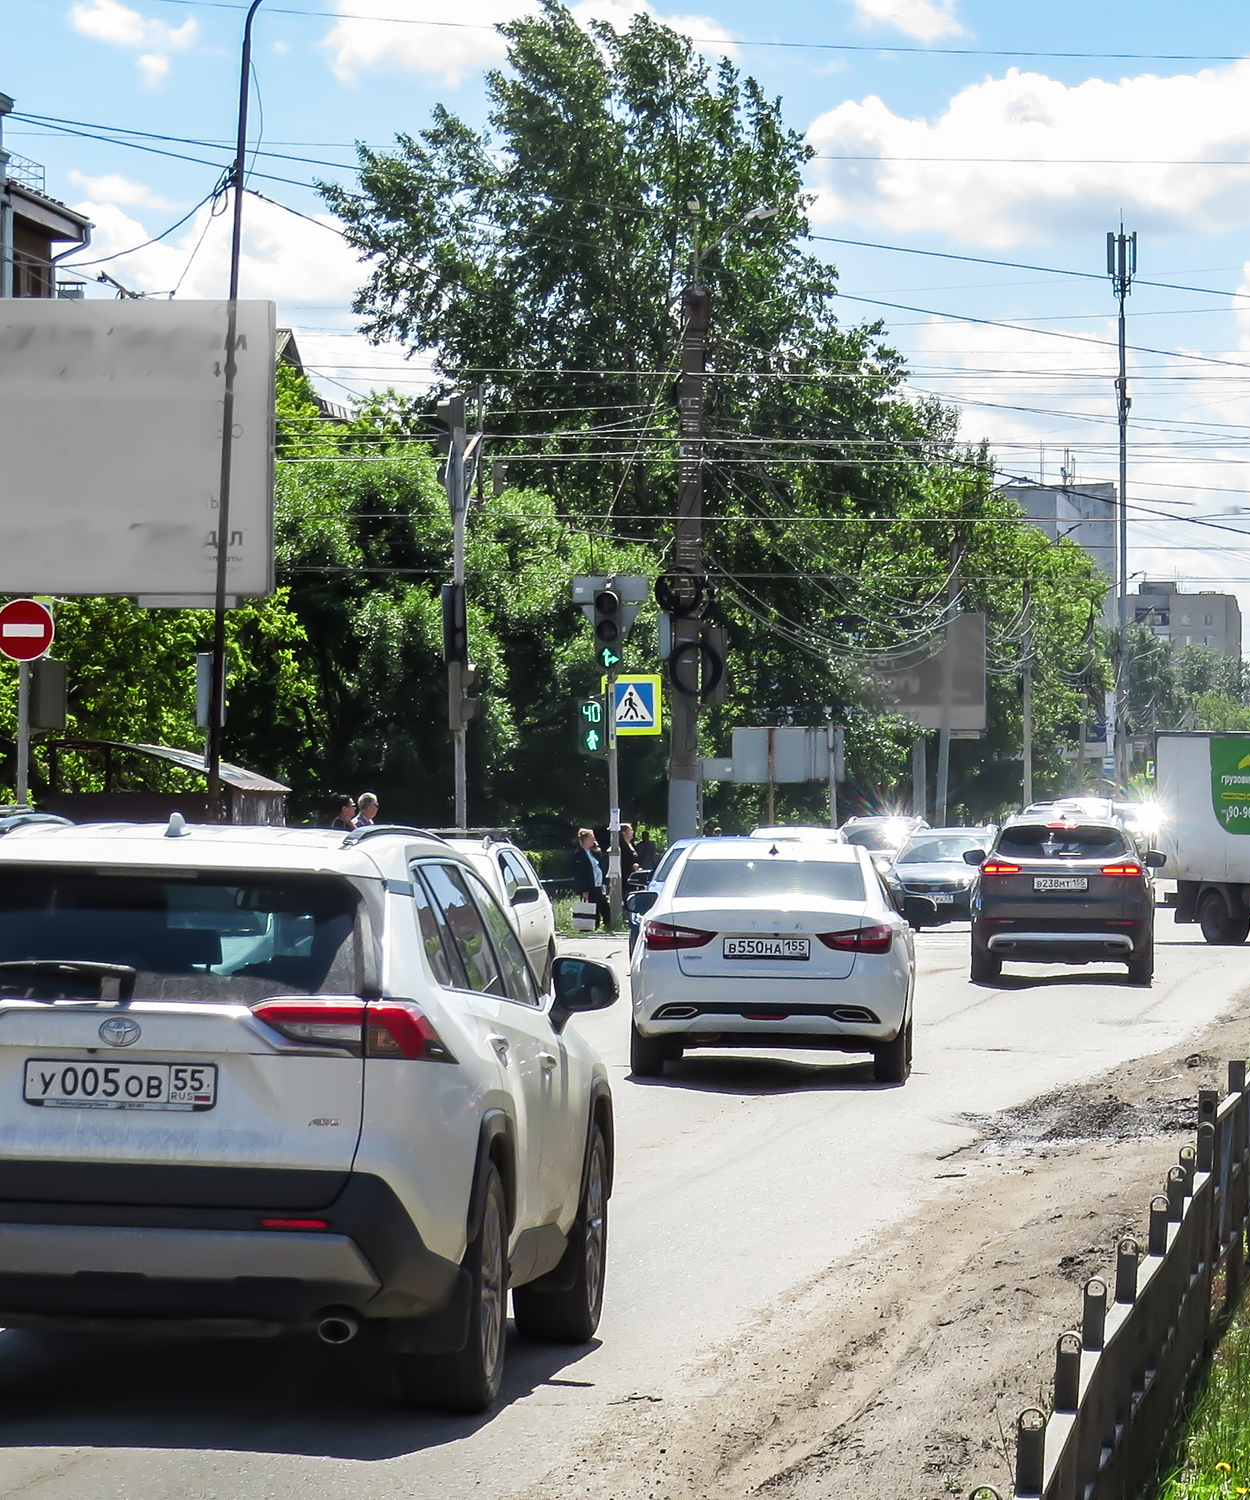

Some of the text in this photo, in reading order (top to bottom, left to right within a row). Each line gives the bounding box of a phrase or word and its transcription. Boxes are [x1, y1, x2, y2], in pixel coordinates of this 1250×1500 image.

[583, 704, 600, 722] 40
[785, 941, 805, 952] 155
[41, 1067, 206, 1098] У005ОВ 55
[171, 1092, 193, 1101] RUS
